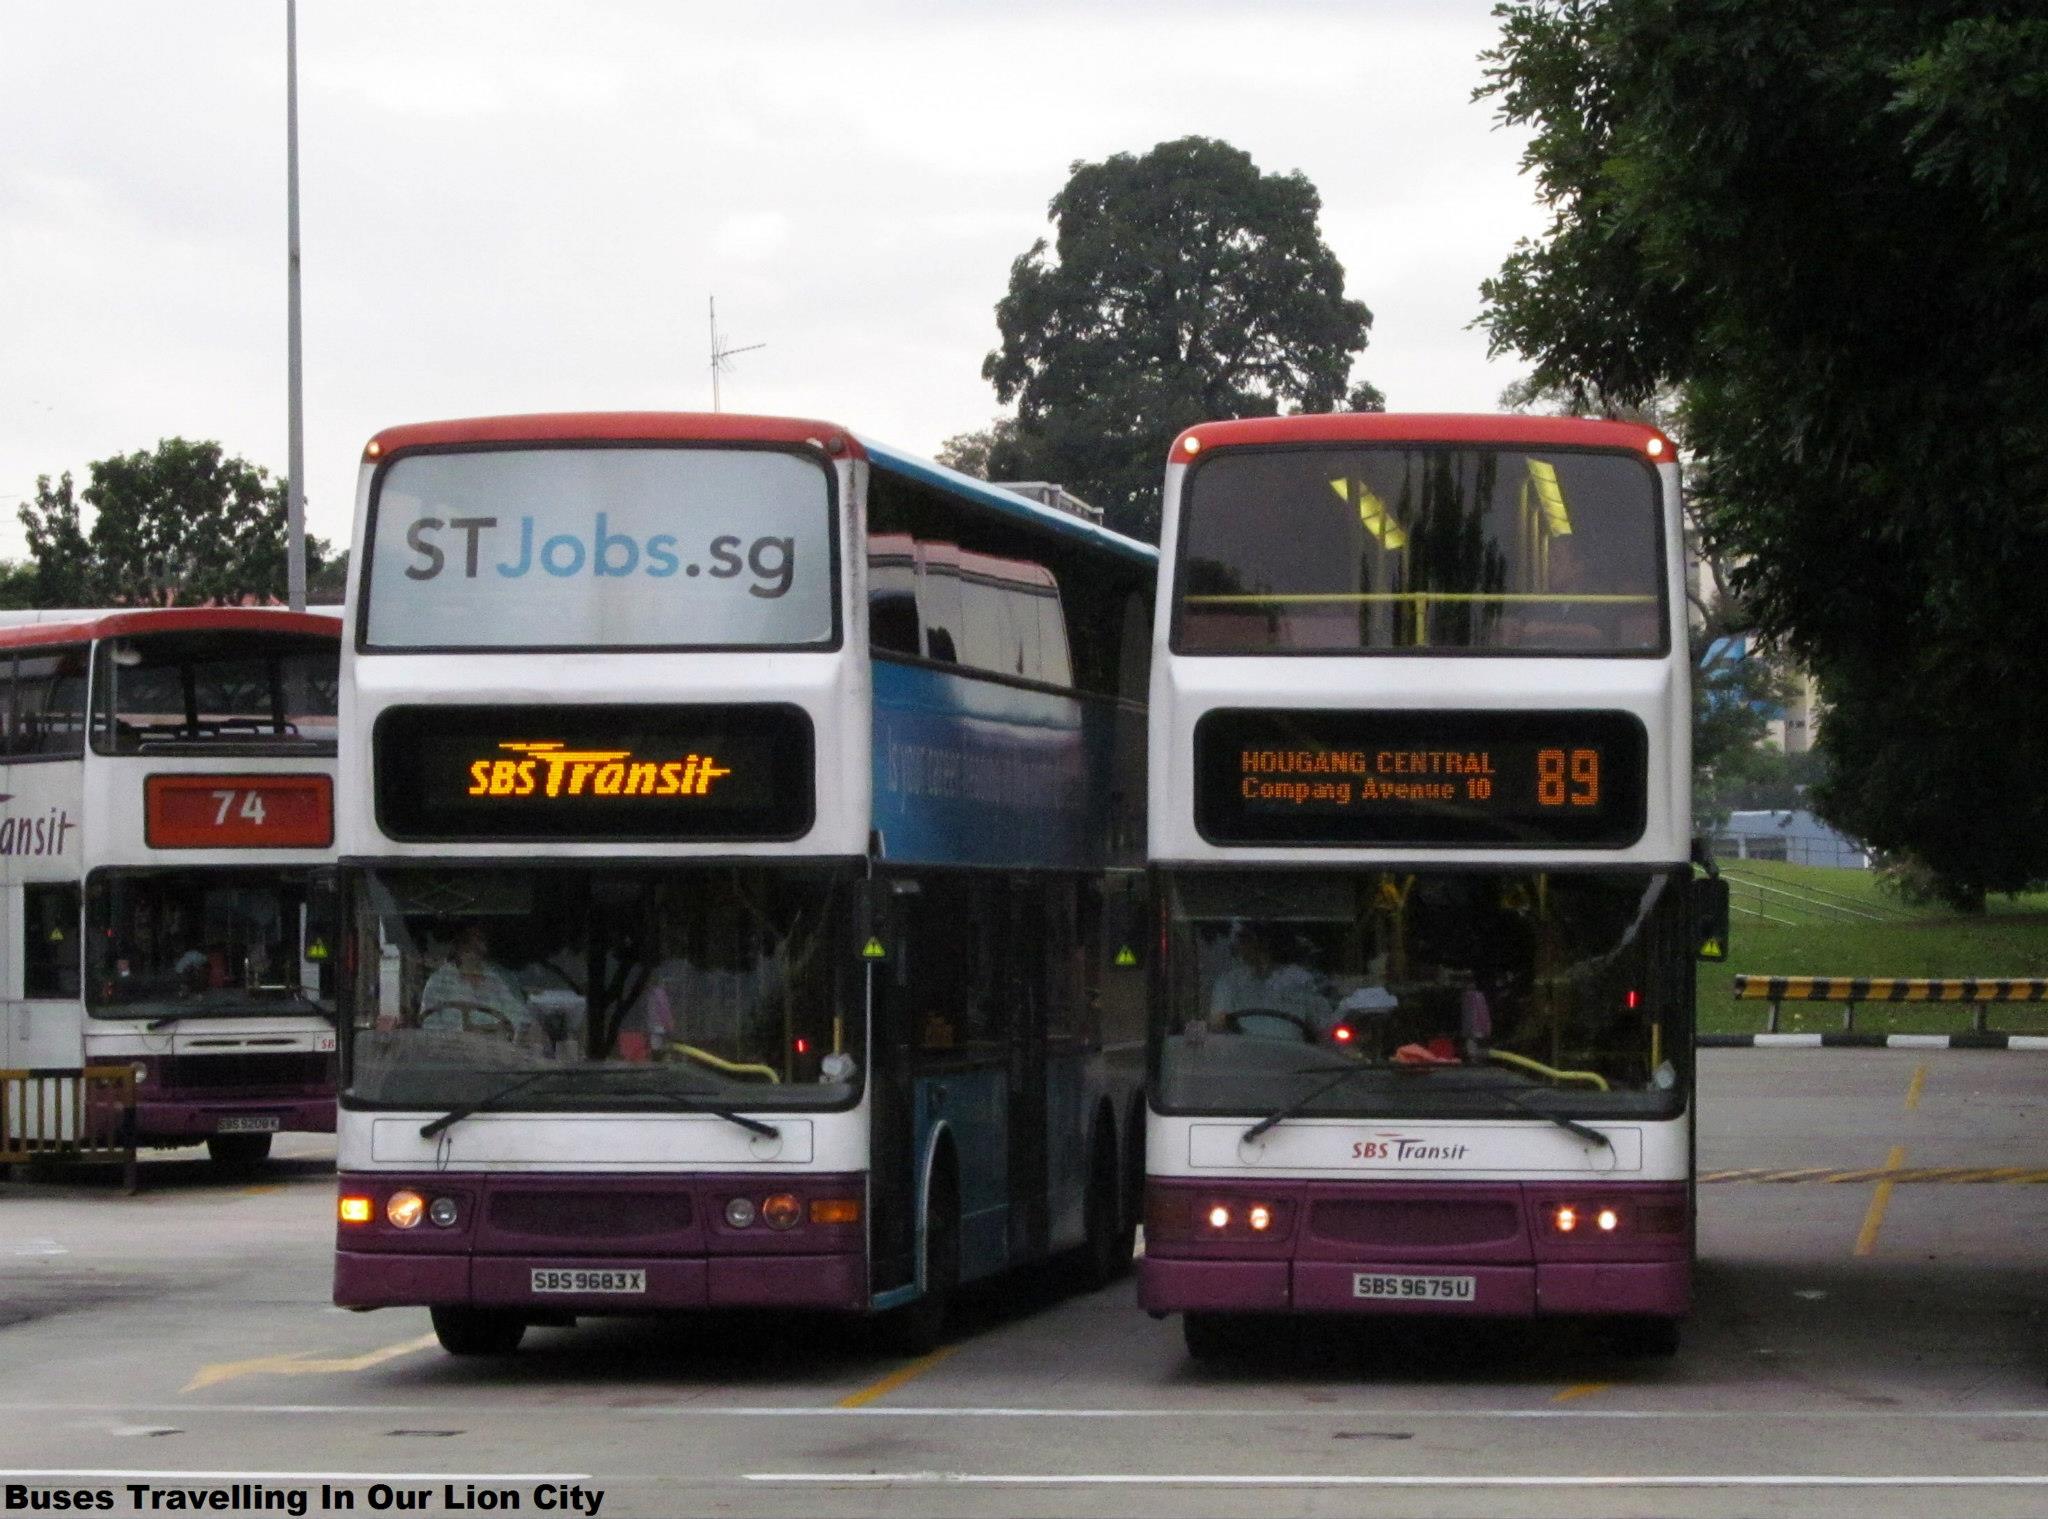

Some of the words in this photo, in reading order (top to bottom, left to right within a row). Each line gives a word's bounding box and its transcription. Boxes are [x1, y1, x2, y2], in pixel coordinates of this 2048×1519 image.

[469, 761, 536, 794] SBS
[528, 752, 730, 797] Transit
[1242, 752, 1366, 773] HOUGANG
[1376, 752, 1495, 773] CENTRAL
[1537, 750, 1598, 805] 89
[1362, 777, 1454, 799] Avenue
[1466, 777, 1492, 799] 10
[211, 790, 266, 825] 74
[0, 797, 76, 855] ansit
[1352, 1142, 1389, 1158] SBS
[1390, 1138, 1469, 1161] Transit
